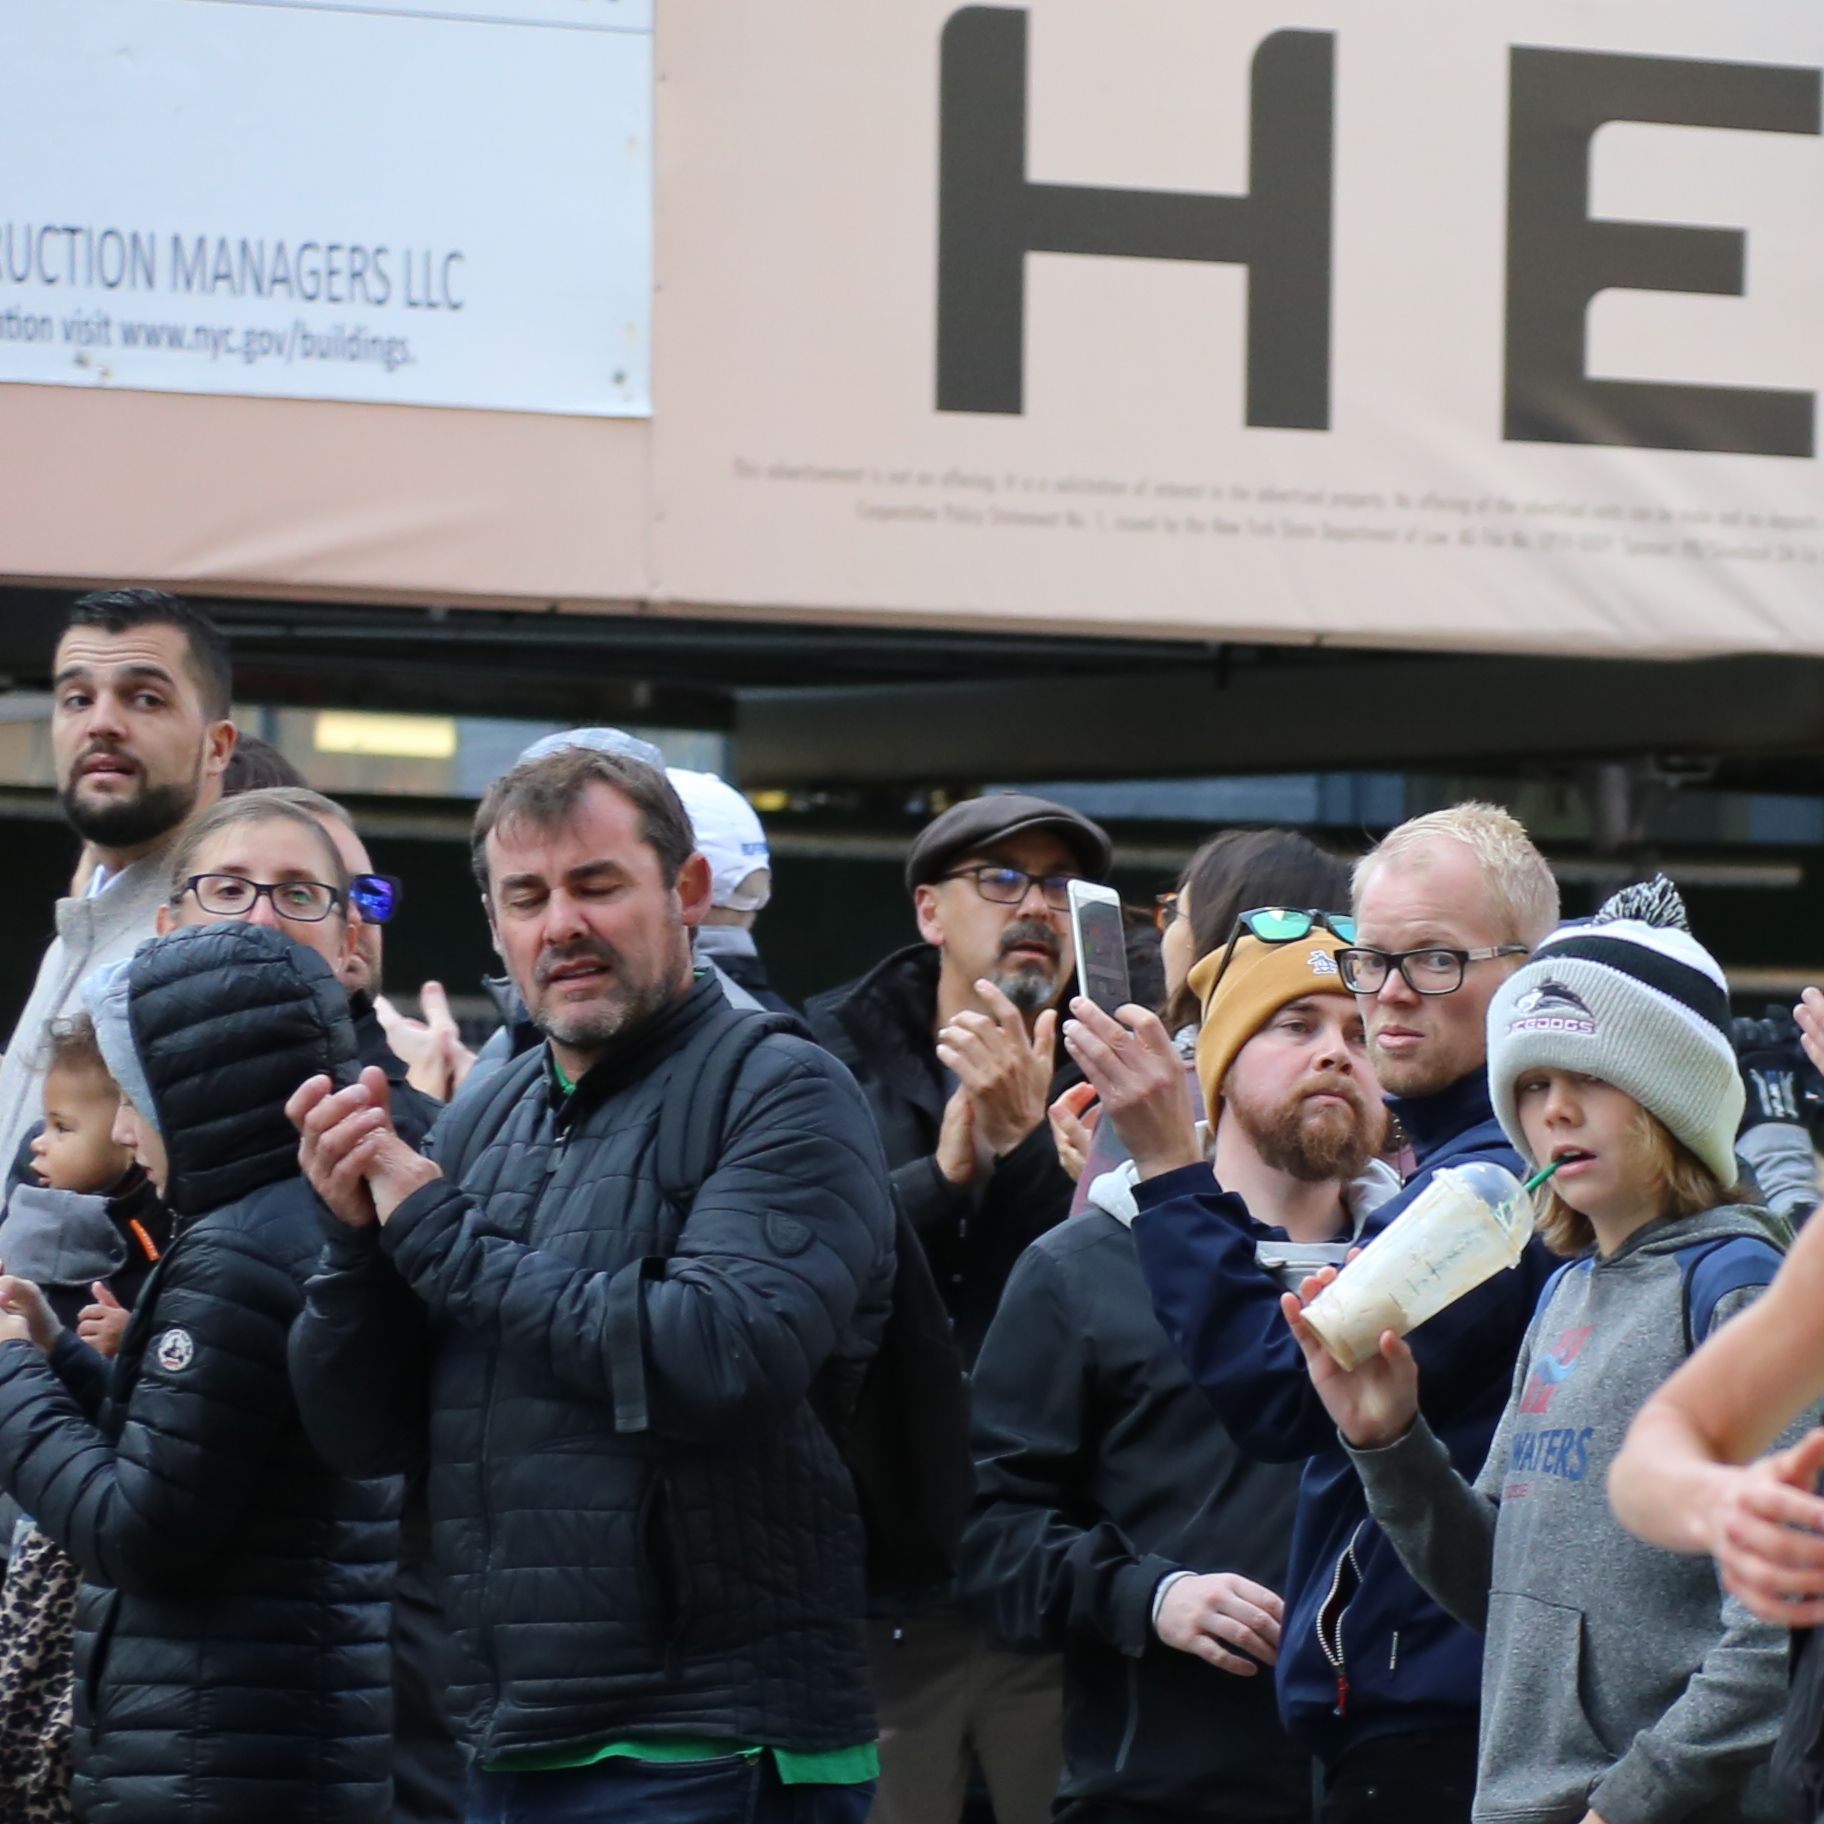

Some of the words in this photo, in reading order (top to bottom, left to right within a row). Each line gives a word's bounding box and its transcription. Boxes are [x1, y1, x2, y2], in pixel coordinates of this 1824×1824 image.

[0, 221, 156, 292] UCTION
[172, 233, 392, 306] MANAGERS
[404, 249, 466, 311] LLC
[60, 307, 113, 347] visit
[121, 317, 418, 372] www.nyc.gov/buildings.
